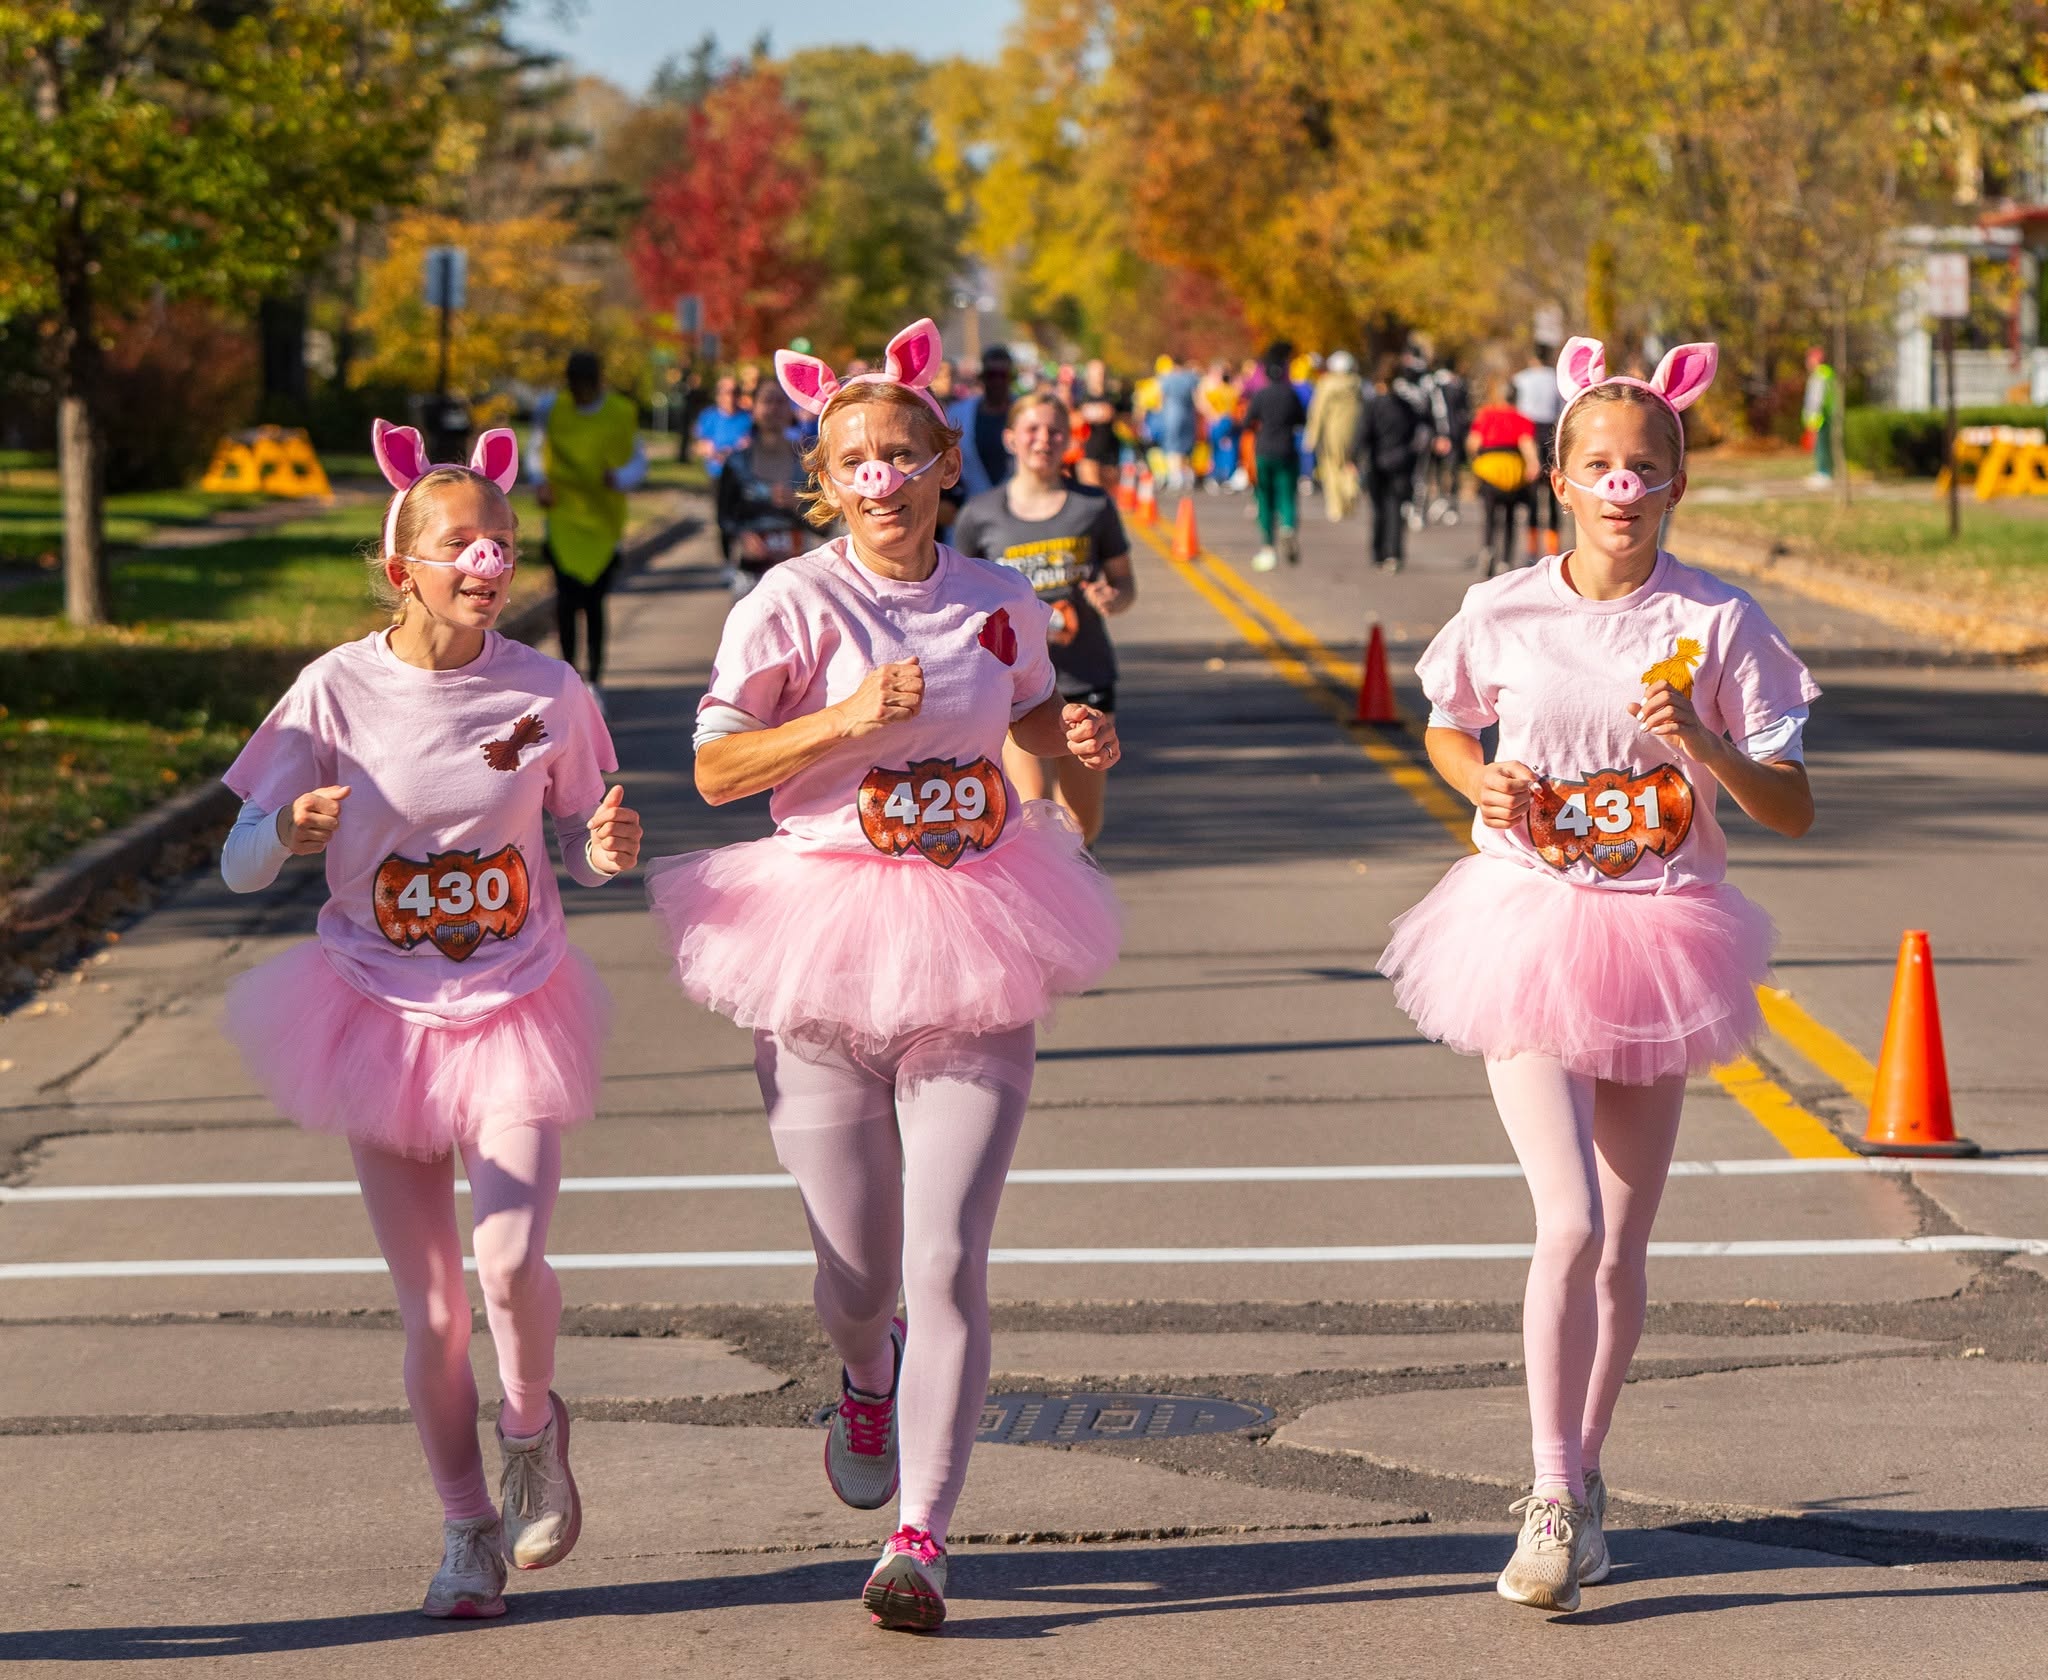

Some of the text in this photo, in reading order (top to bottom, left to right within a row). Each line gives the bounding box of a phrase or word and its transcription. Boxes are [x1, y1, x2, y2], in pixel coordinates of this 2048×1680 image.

[884, 776, 986, 825] 429
[1555, 785, 1661, 837] 431
[1593, 840, 1636, 863] NIGHTMARE
[1609, 852, 1622, 865] 5K
[398, 867, 510, 917] 430
